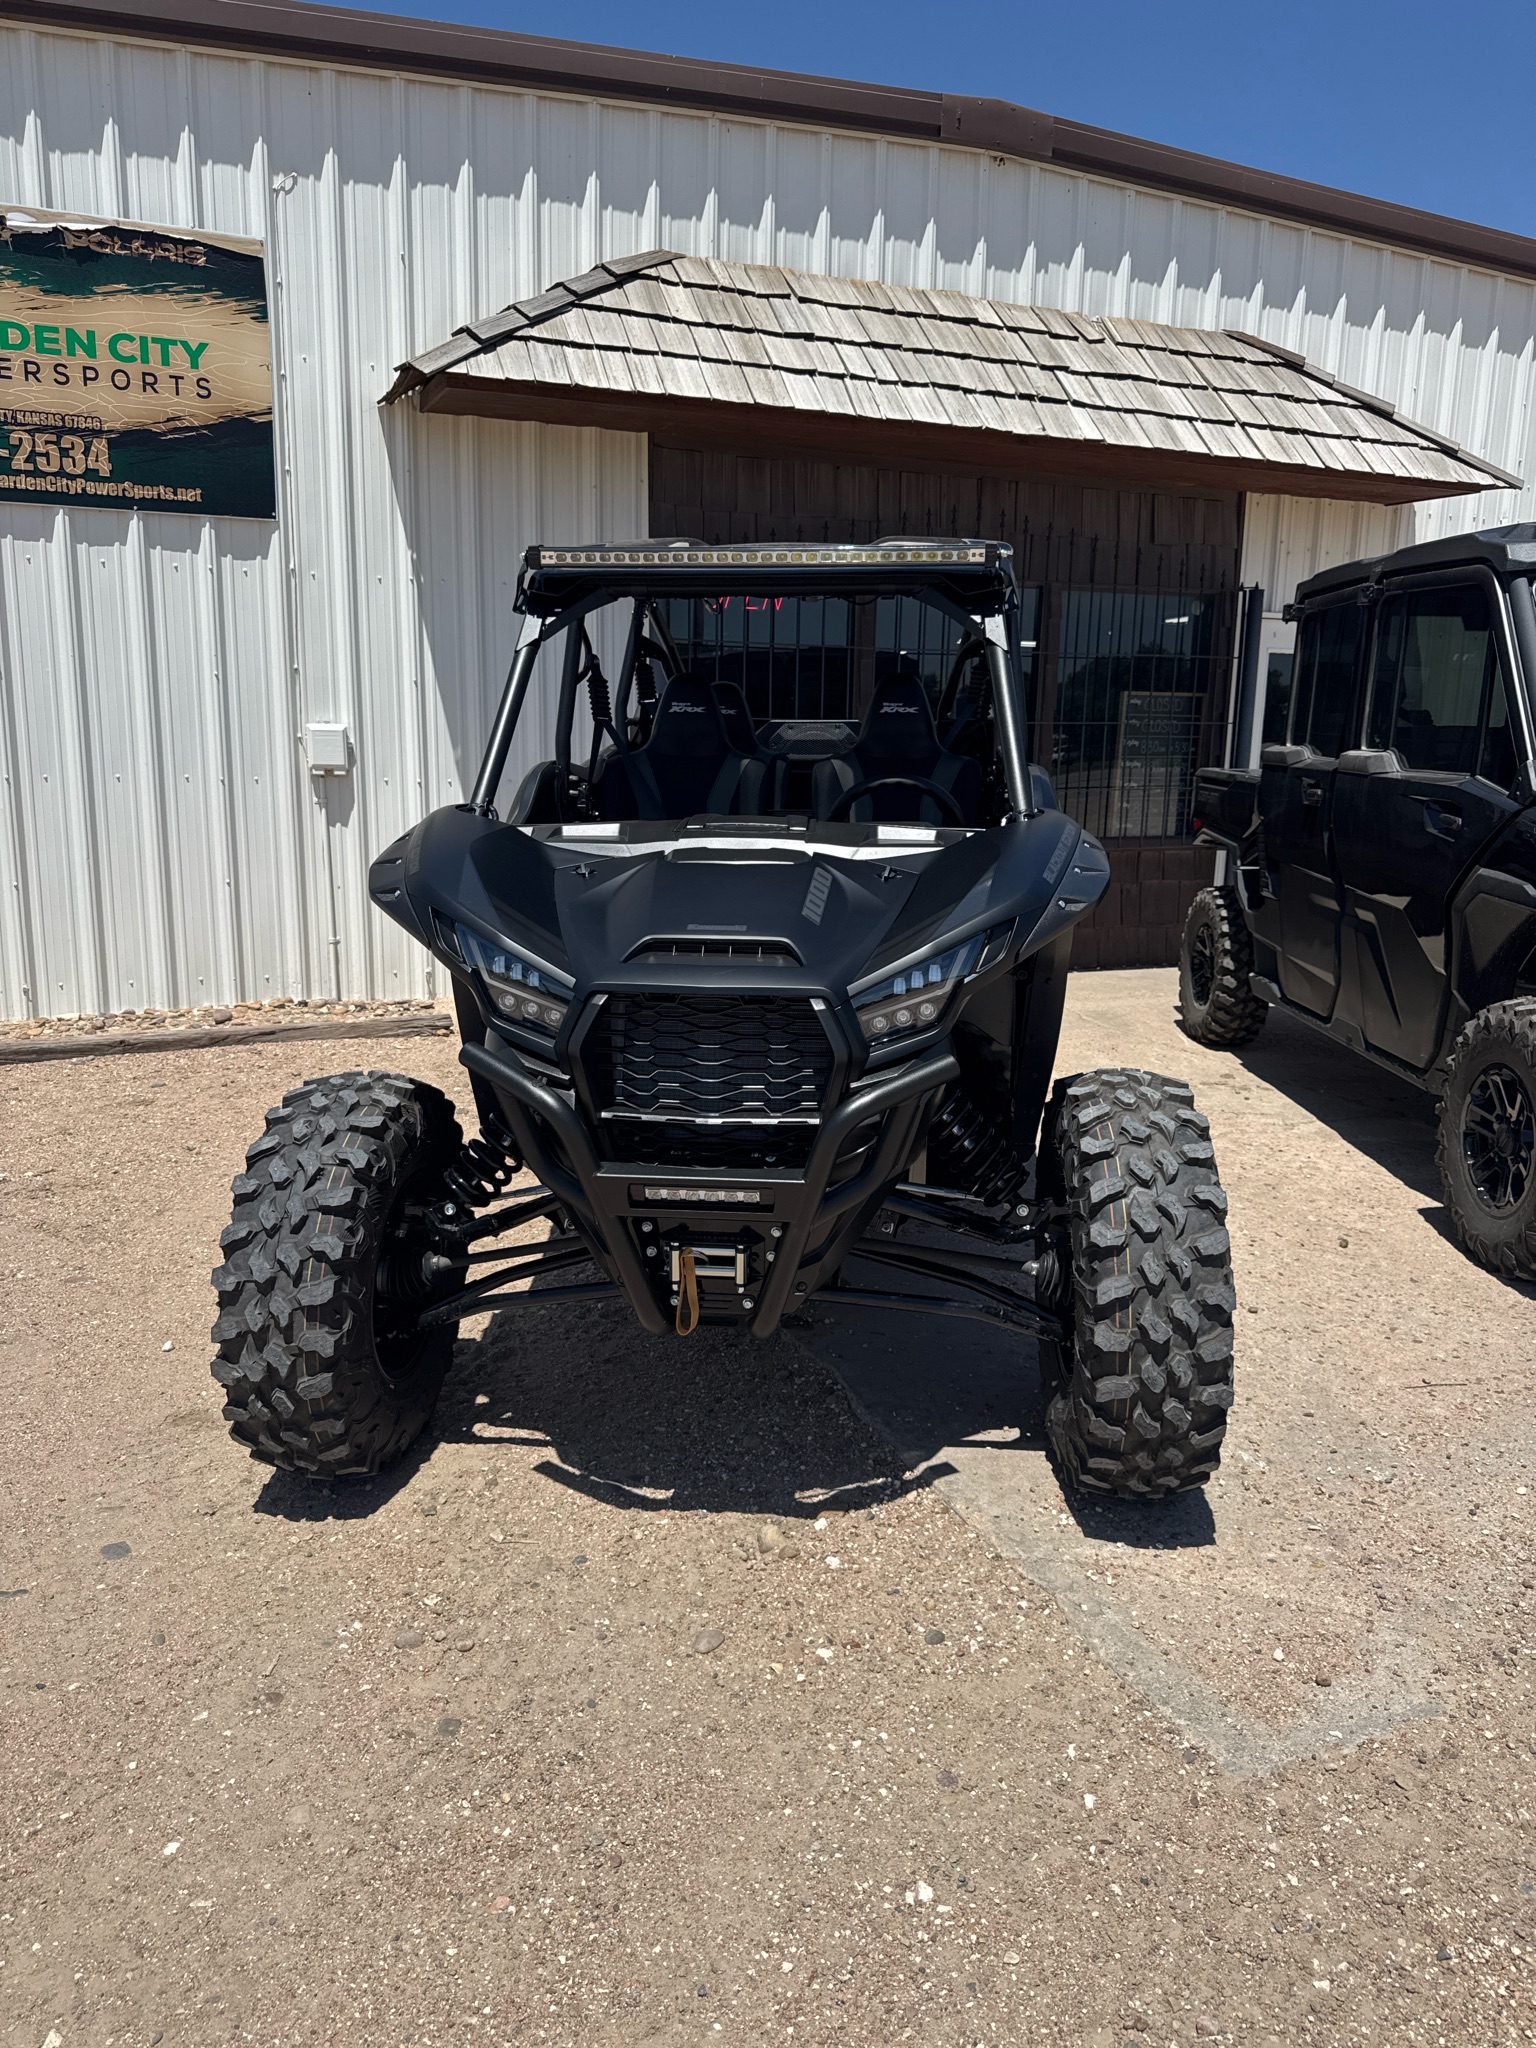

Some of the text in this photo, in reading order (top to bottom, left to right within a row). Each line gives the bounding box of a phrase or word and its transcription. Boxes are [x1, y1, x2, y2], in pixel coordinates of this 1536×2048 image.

[0, 320, 210, 370] DEN CITY
[0, 357, 212, 400] ERSPORTS
[16, 410, 63, 427] KANSAS
[64, 415, 102, 431] 67846
[1143, 697, 1183, 712] CLOSD
[1141, 718, 1181, 734] CLOSD
[801, 866, 833, 926] 1000
